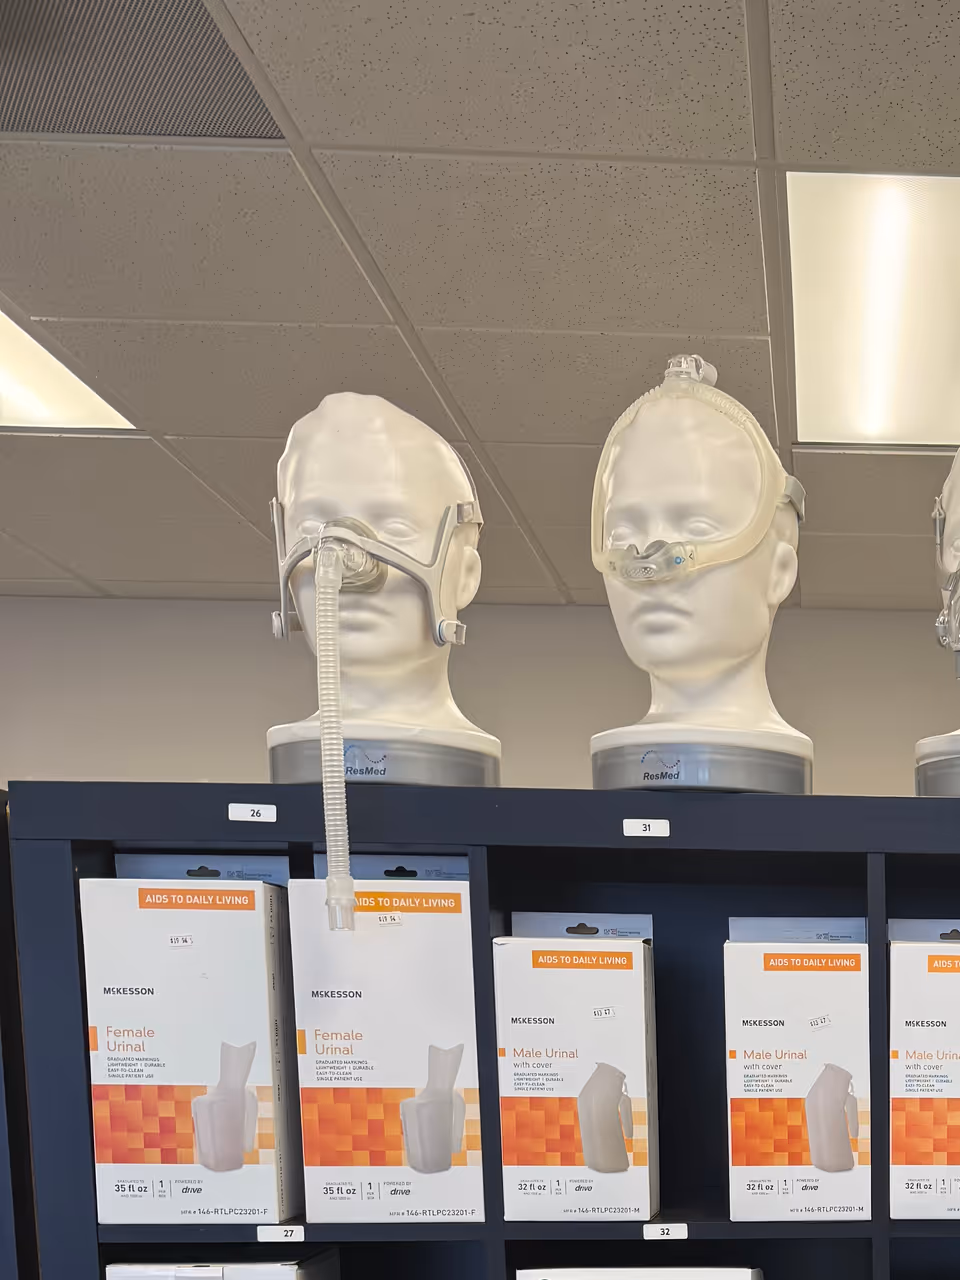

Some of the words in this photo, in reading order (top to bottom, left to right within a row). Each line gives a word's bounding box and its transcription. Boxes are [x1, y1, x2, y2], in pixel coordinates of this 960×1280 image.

[344, 765, 386, 776] ResMed
[643, 771, 680, 780] ResMed
[250, 809, 261, 818] 26
[642, 824, 651, 832] 31
[145, 894, 168, 903] AIDS
[171, 895, 183, 903] TO
[186, 895, 213, 904] DAILY
[216, 896, 248, 904] LIVING
[377, 896, 390, 906] TO
[393, 898, 420, 907] DAILY
[423, 898, 455, 907] LIVING
[560, 956, 571, 964] TO
[573, 956, 597, 964] DAILY
[769, 958, 788, 966] AIDS
[790, 958, 801, 966] TO
[933, 960, 952, 968] AIDS
[106, 1026, 155, 1038] Female
[314, 1029, 363, 1041] Female
[107, 1041, 145, 1052] Urinal
[315, 1044, 354, 1056] Urinal
[513, 1048, 542, 1058] Male
[545, 1048, 578, 1058] Urinal
[744, 1050, 772, 1060] Male
[775, 1050, 807, 1059] Urinal
[906, 1050, 933, 1060] Male
[115, 1184, 126, 1192] 35
[128, 1184, 135, 1192] fl
[323, 1187, 334, 1195] 35
[284, 1229, 294, 1237] 27
[660, 1228, 670, 1236] 32
